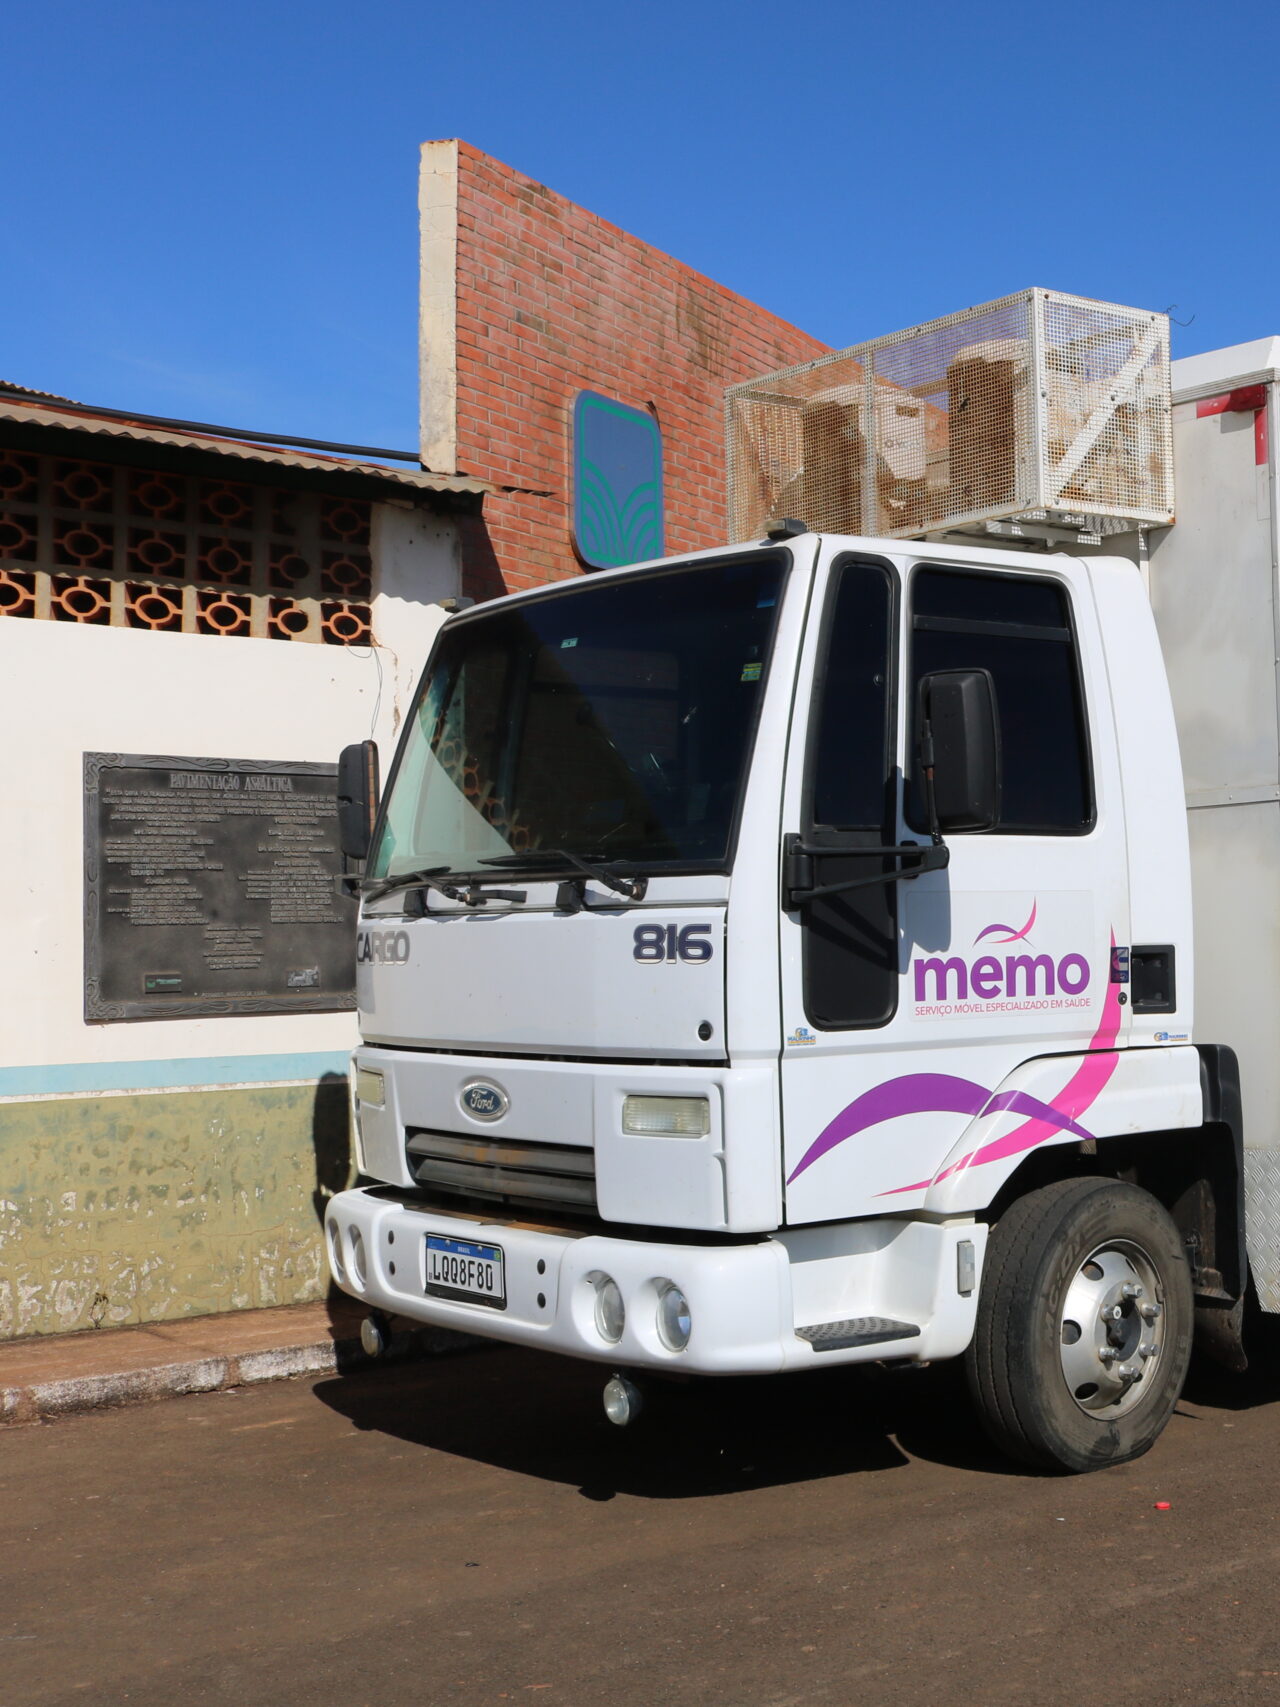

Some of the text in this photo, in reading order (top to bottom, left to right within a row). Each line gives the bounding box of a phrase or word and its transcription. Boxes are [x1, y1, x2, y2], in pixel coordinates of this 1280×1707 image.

[357, 930, 411, 966] CARGO
[633, 923, 714, 965] 816
[914, 953, 1091, 1002] memo
[915, 997, 1091, 1017] SERVIÇO MÓVEL ESPECIALIZADO EM SAÚDE
[470, 1089, 495, 1110] Ford
[433, 1253, 493, 1291] LQQ8F80
